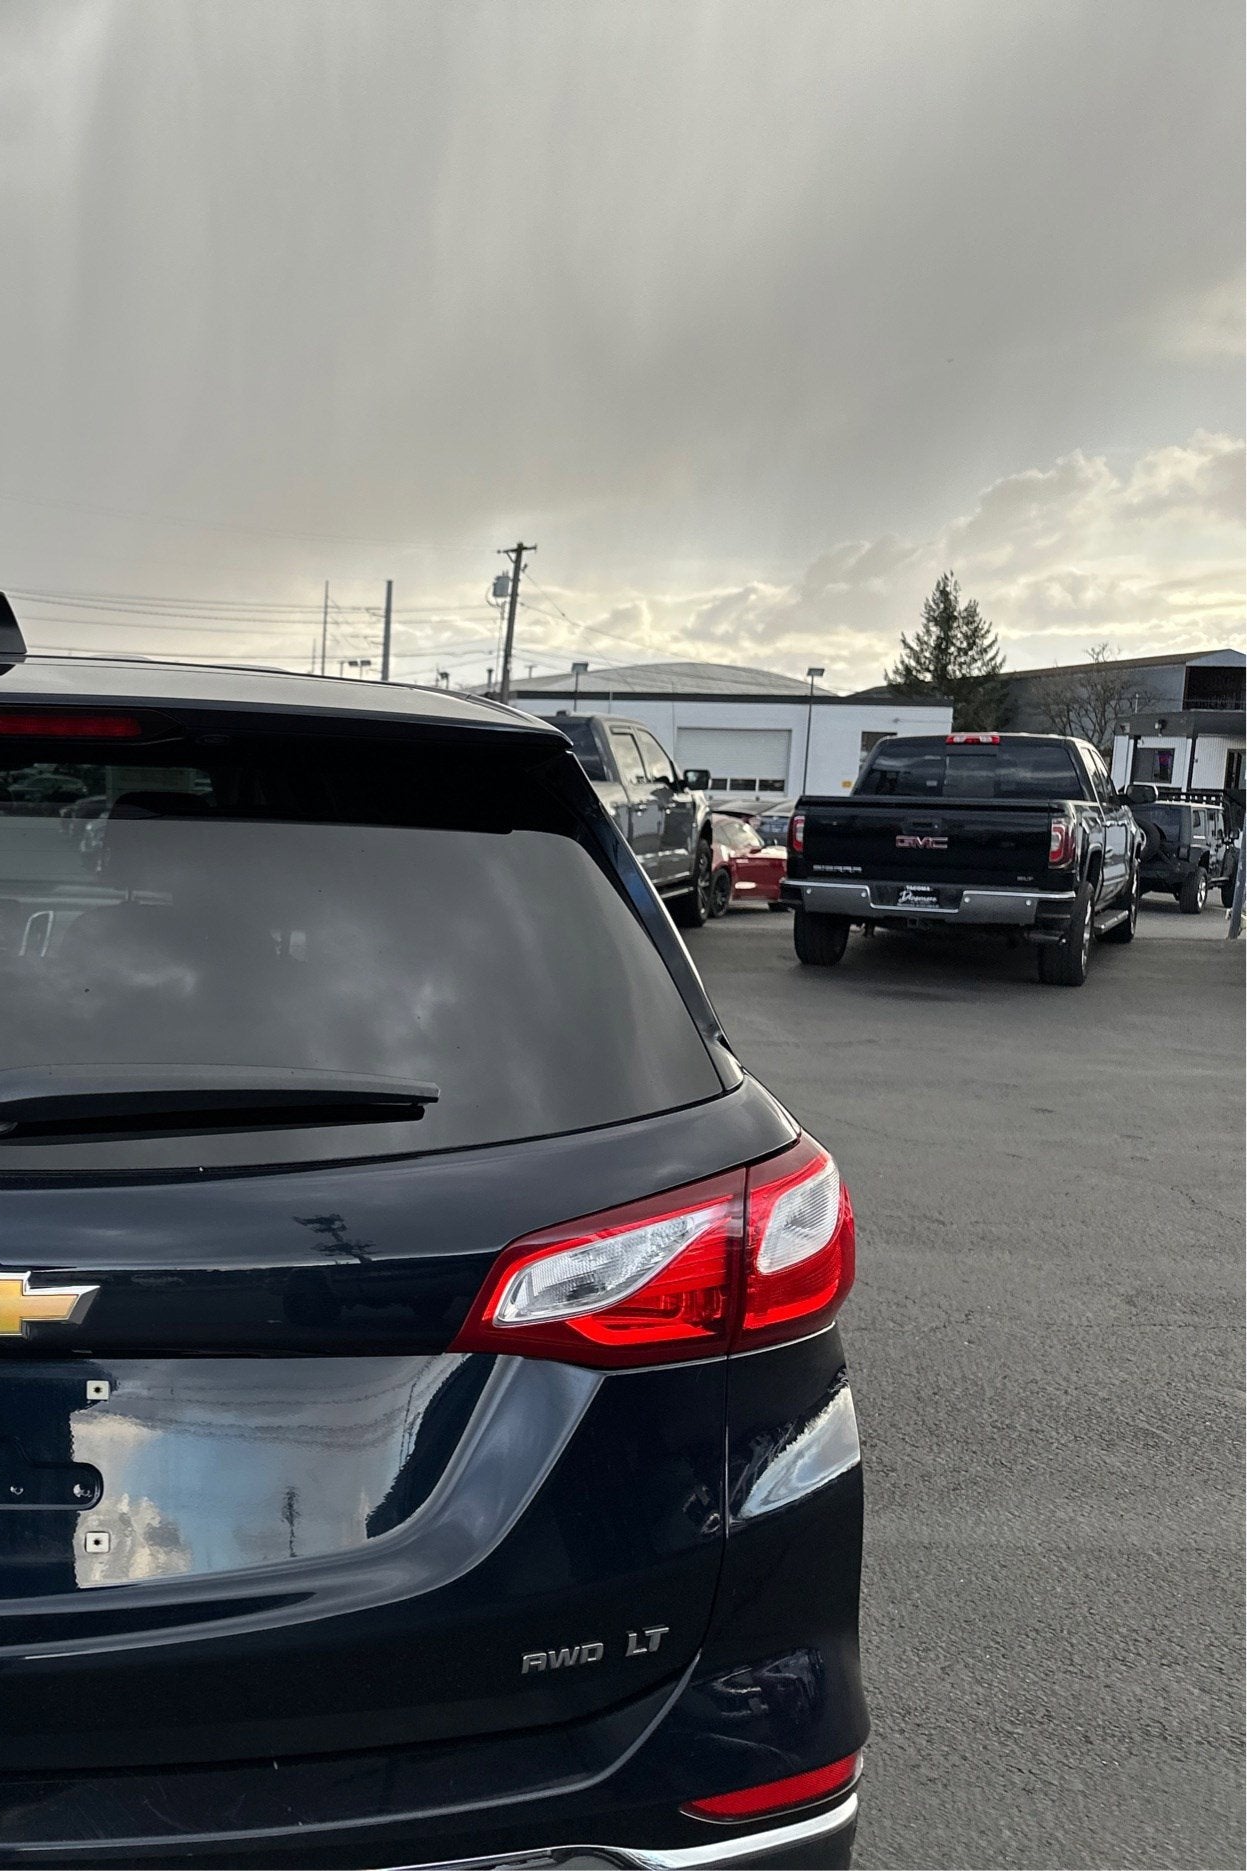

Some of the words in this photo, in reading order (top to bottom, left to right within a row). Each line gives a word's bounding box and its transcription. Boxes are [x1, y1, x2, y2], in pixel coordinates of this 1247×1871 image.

[895, 835, 948, 849] GMC
[521, 1641, 604, 1674] AWD
[625, 1624, 670, 1657] LT
